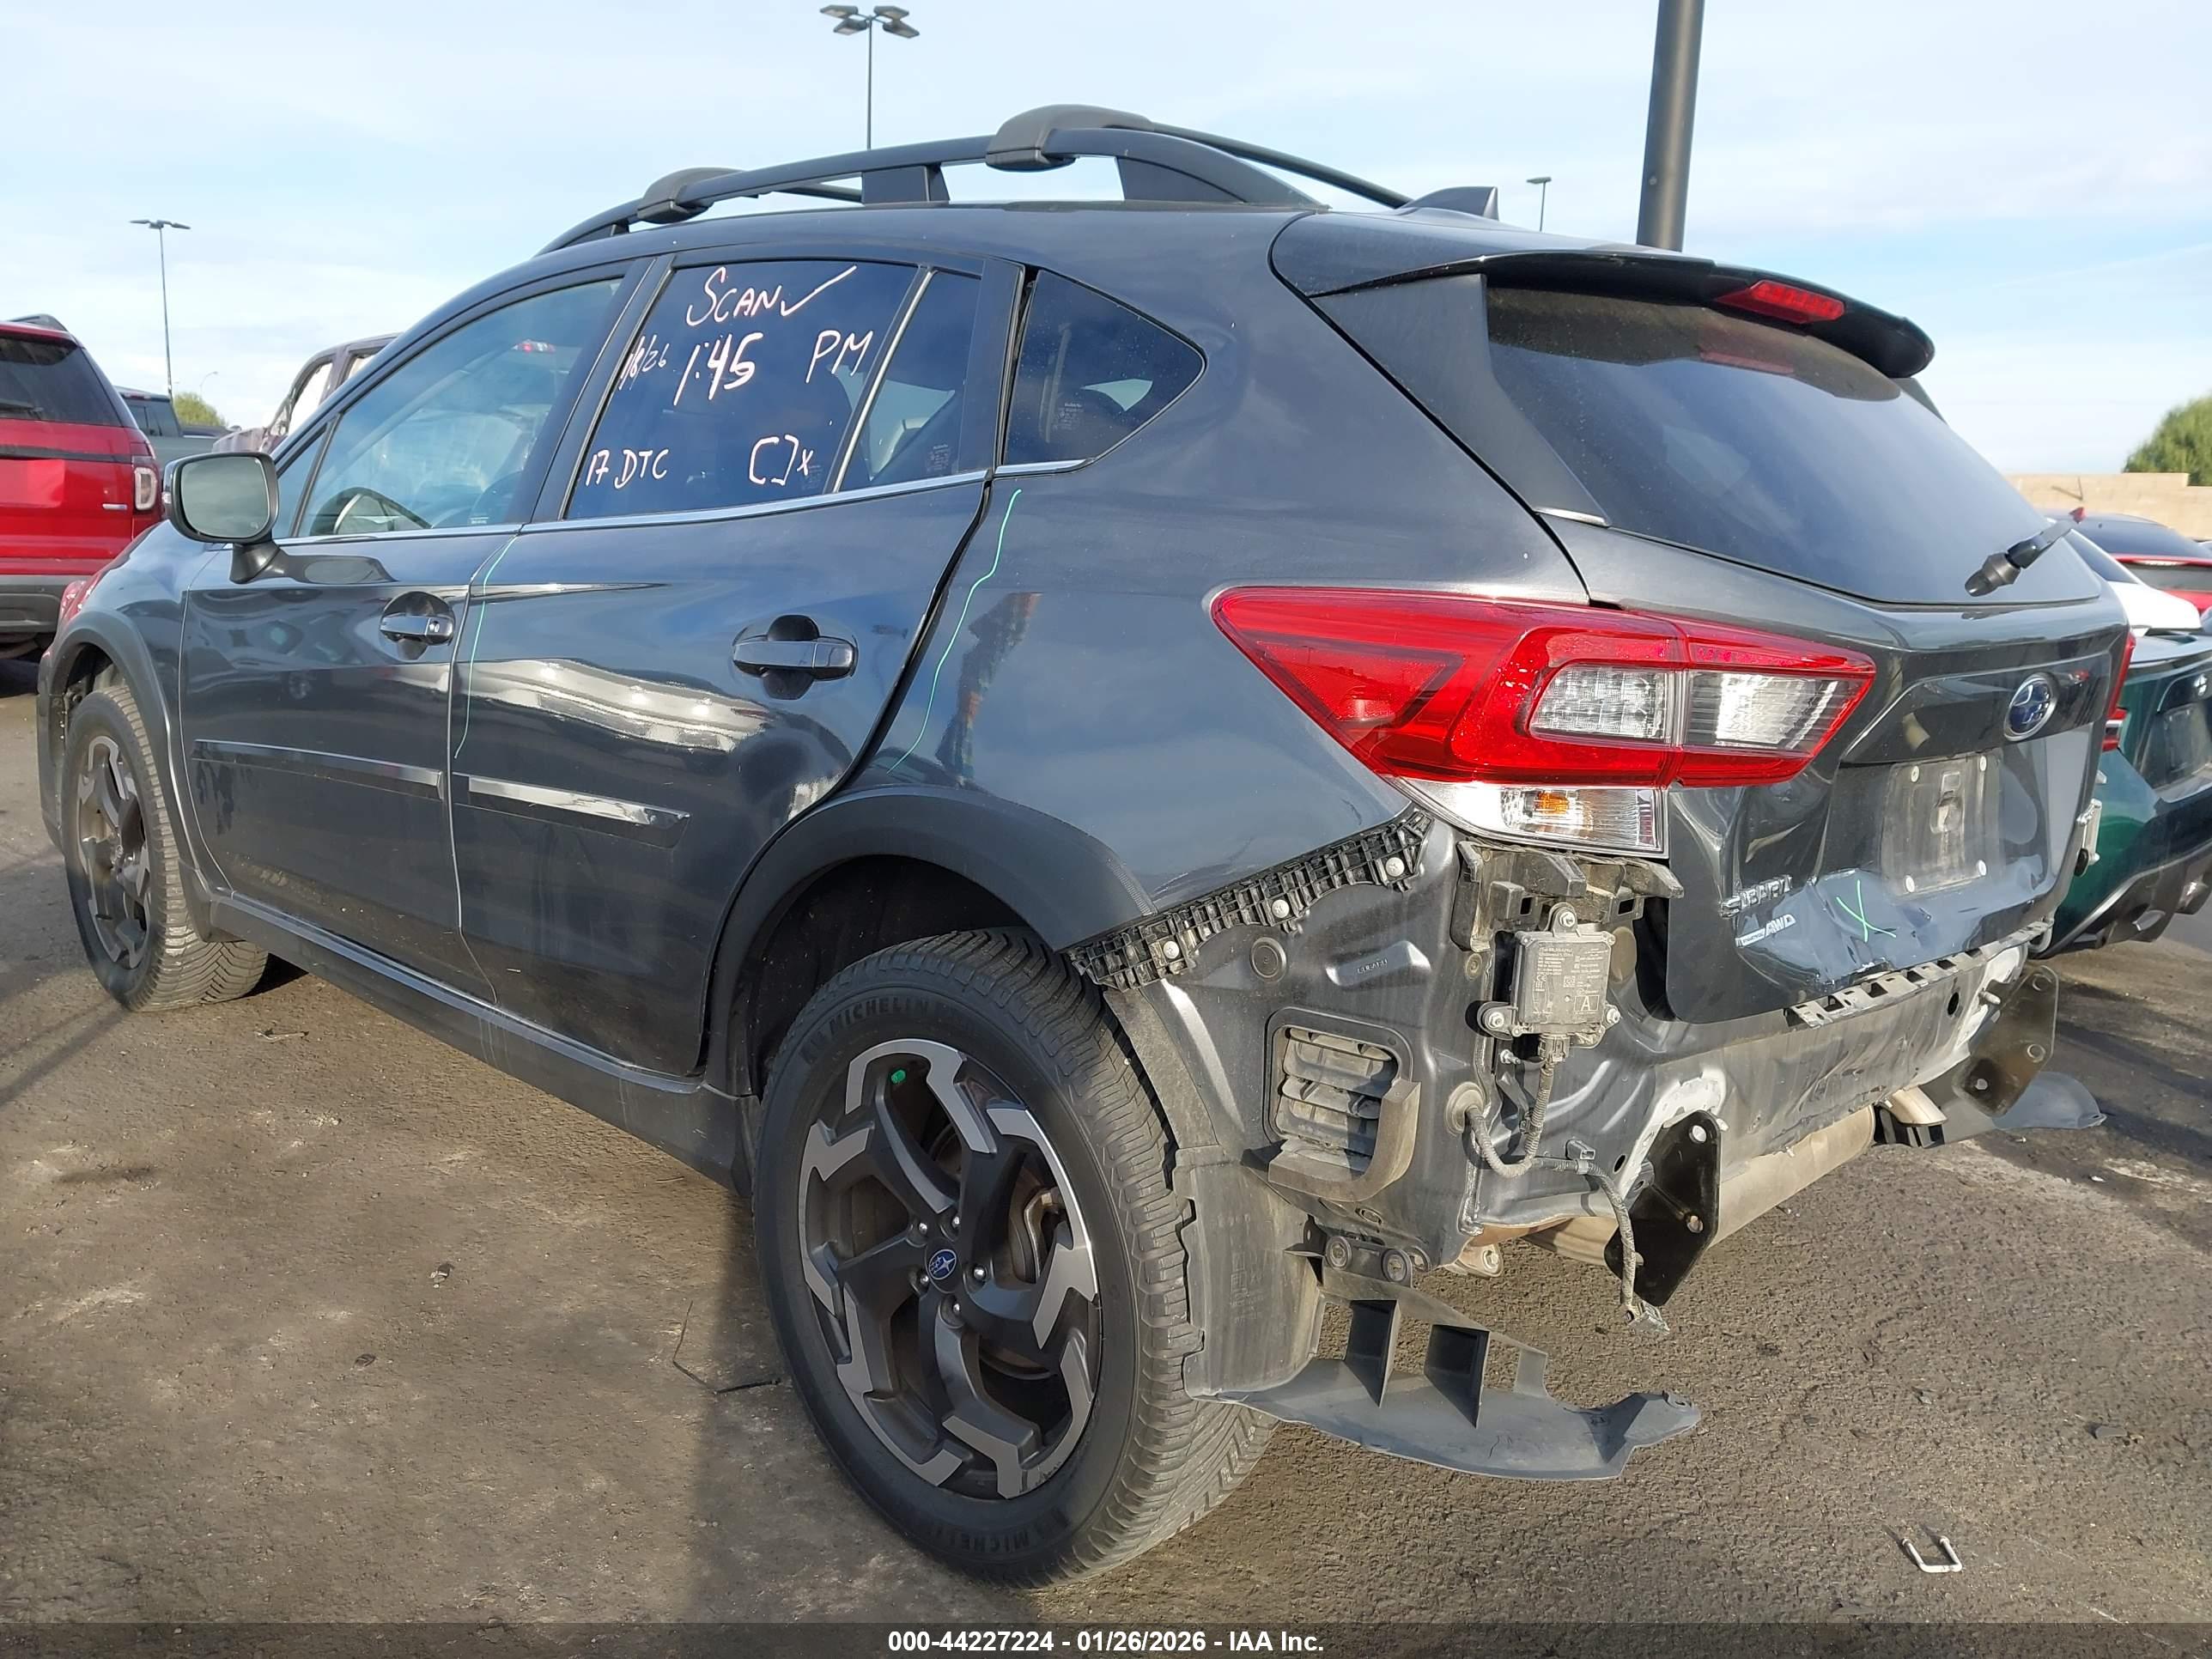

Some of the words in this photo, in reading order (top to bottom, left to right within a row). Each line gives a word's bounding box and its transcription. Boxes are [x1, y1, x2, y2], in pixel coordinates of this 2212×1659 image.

[685, 265, 782, 327] SCAN
[673, 331, 764, 406] 1:45
[805, 329, 874, 384] PM
[613, 448, 669, 489] DTC
[1765, 914, 1797, 938] AWD
[830, 996, 929, 1037] MICHELIN
[1580, 995, 1591, 1012] A
